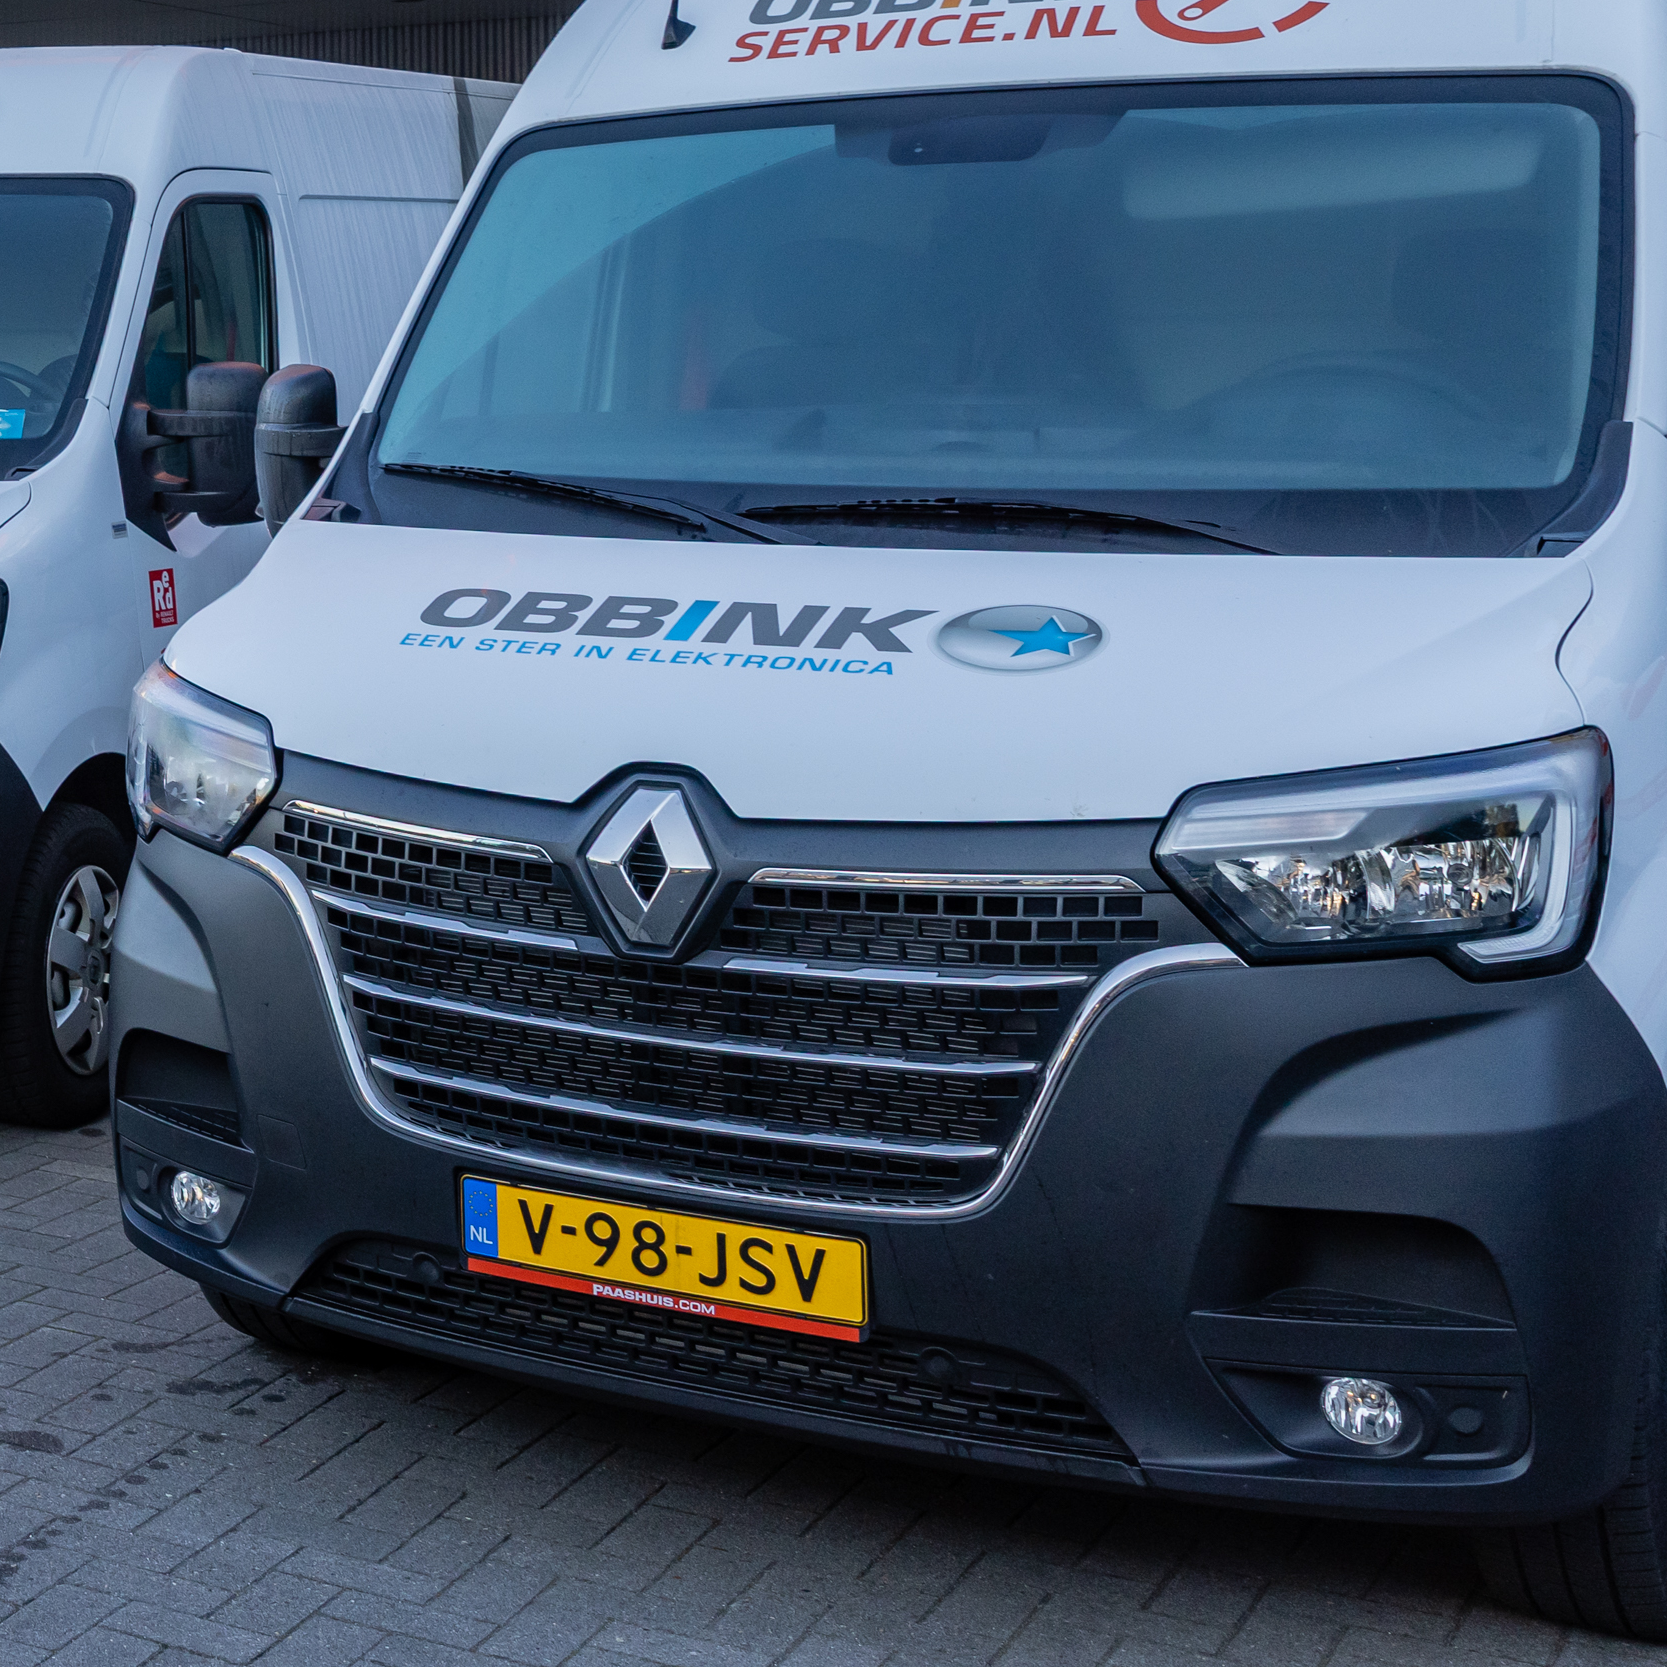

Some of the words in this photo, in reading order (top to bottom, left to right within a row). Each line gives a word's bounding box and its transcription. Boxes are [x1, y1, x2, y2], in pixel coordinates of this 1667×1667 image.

[727, 5, 1118, 63] SERVICE.NL
[419, 587, 941, 654] OBBINK
[398, 632, 467, 650] EEN
[474, 638, 562, 657] STER
[573, 644, 615, 660] IN
[625, 647, 895, 676] ELEKTRONICA
[469, 1225, 494, 1245] NL
[517, 1198, 827, 1303] V-98-JSV
[592, 1283, 716, 1316] PAASHUIS.COM
